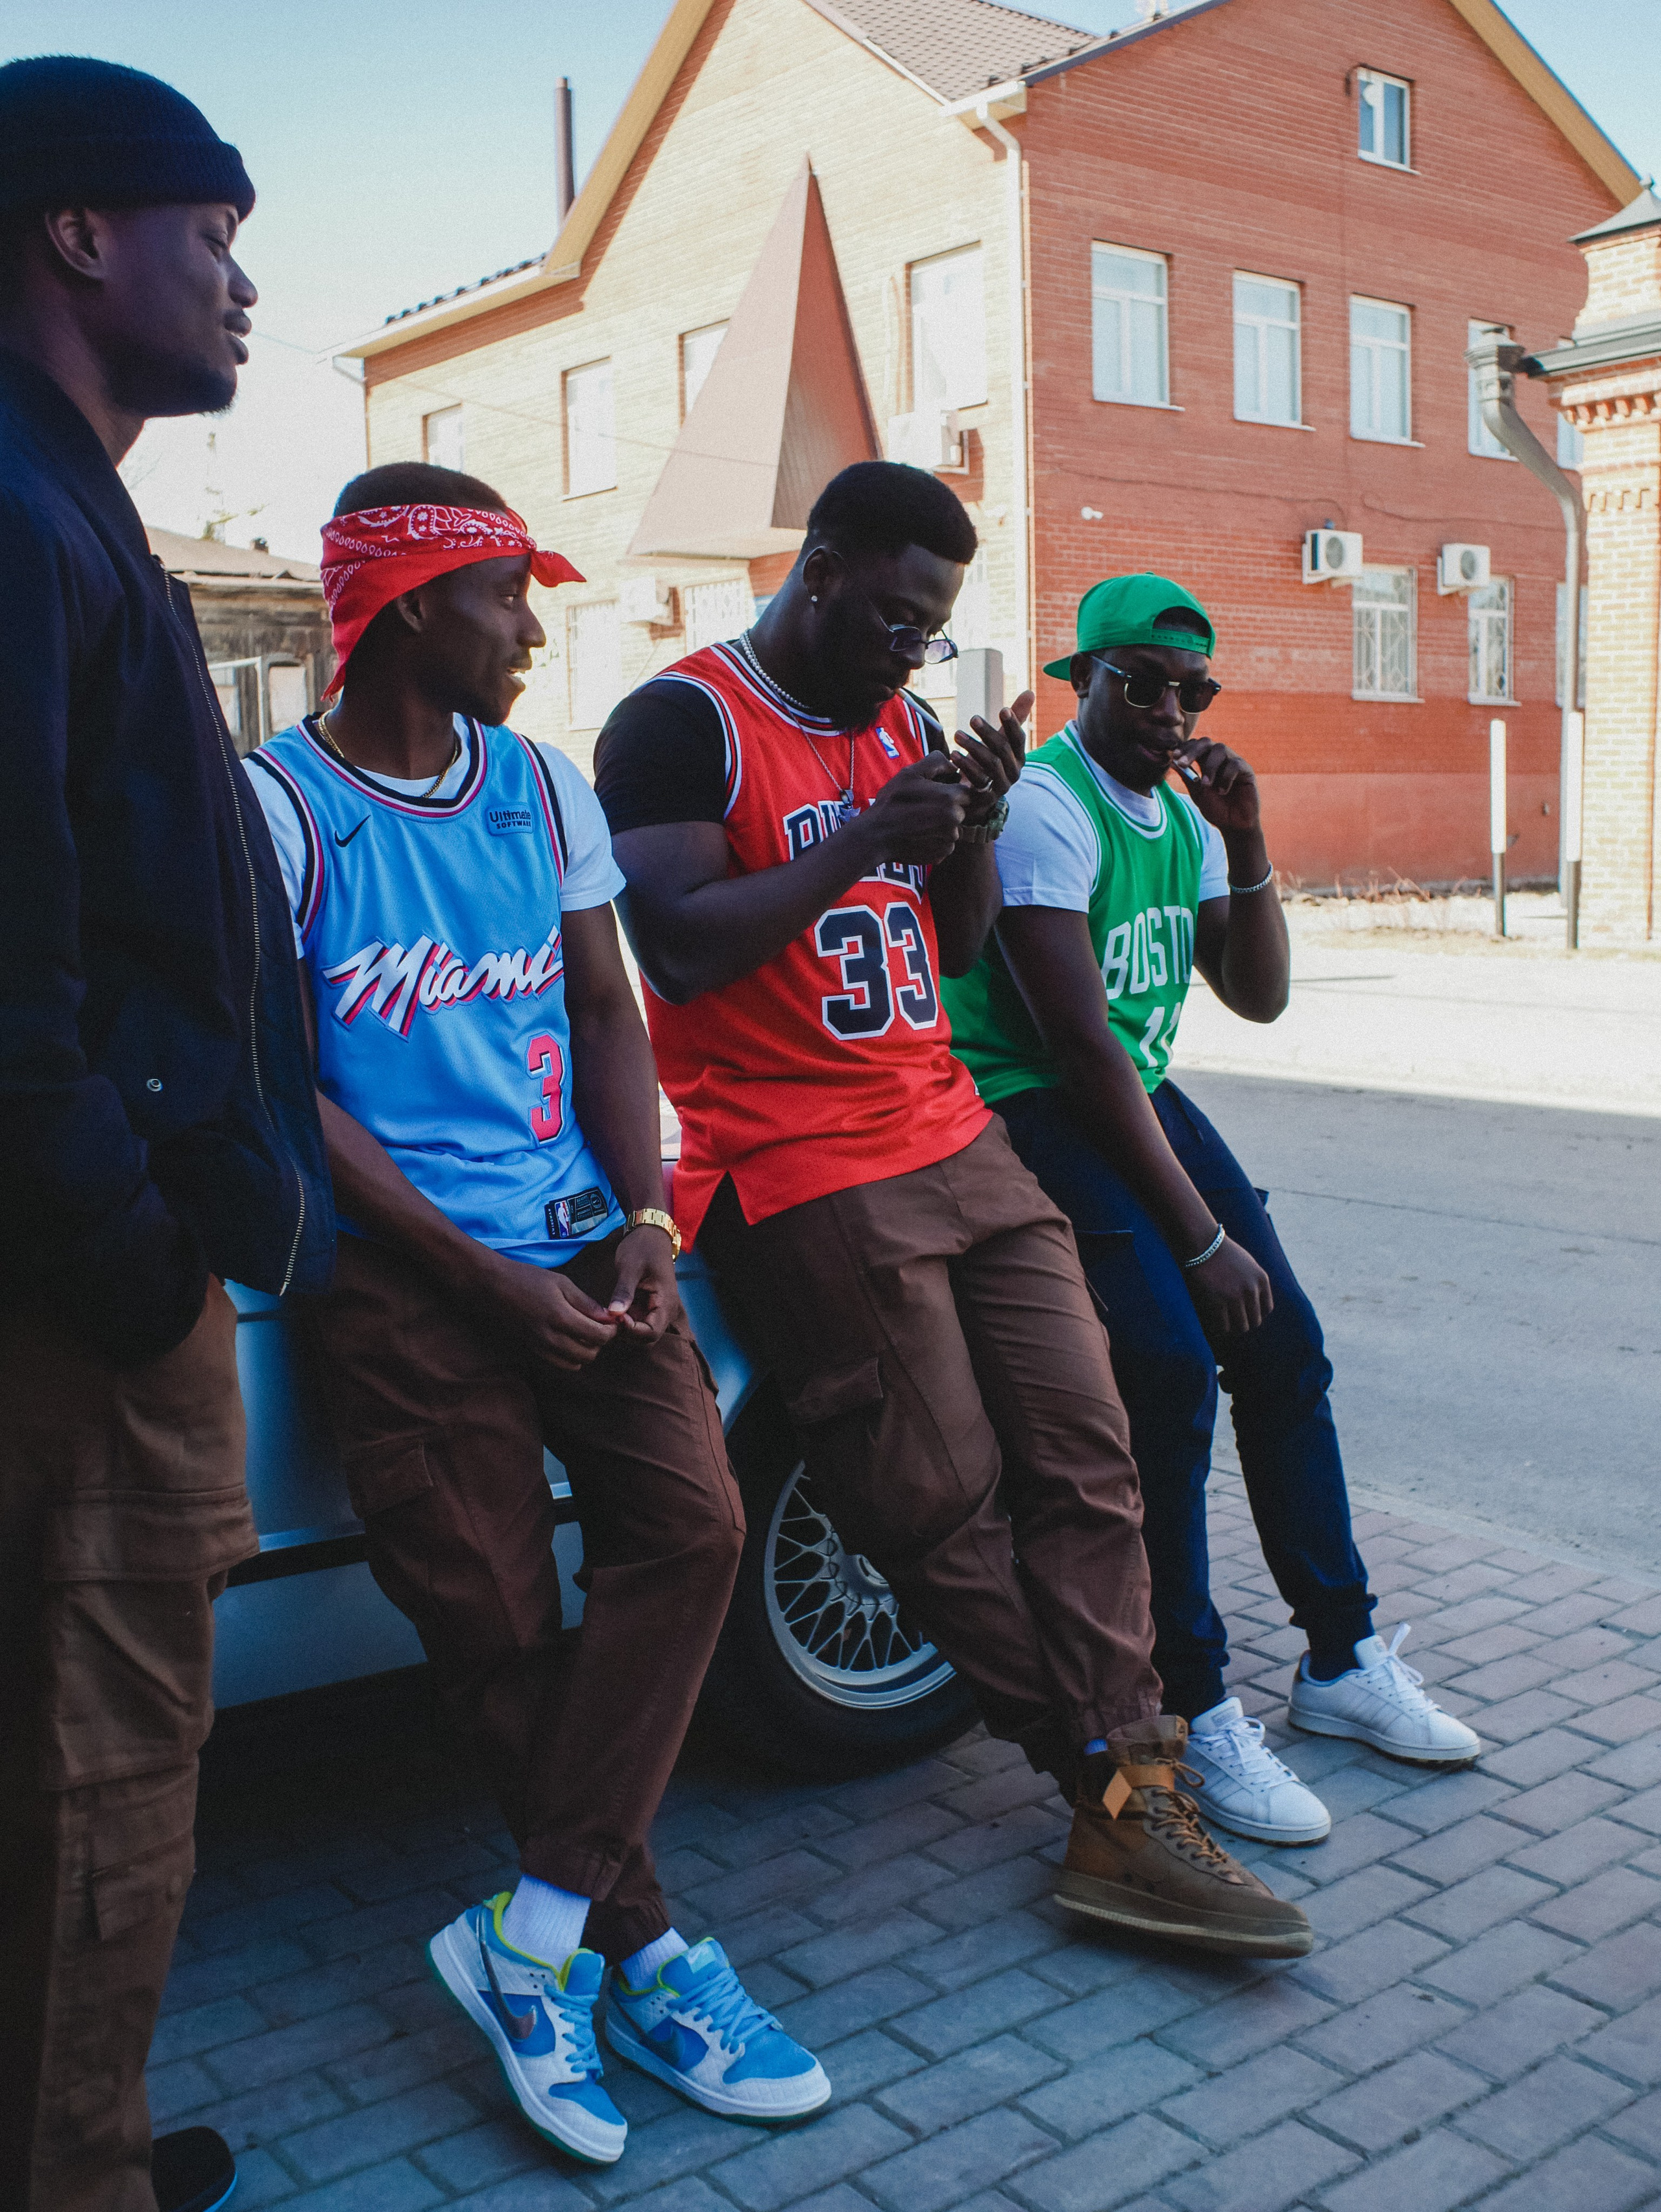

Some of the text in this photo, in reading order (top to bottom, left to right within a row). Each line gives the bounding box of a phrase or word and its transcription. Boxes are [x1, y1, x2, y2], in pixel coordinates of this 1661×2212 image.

[489, 809, 531, 822] Ultimate
[322, 925, 564, 1038] Miami
[814, 901, 938, 1041] 33
[527, 1034, 566, 1145] 3
